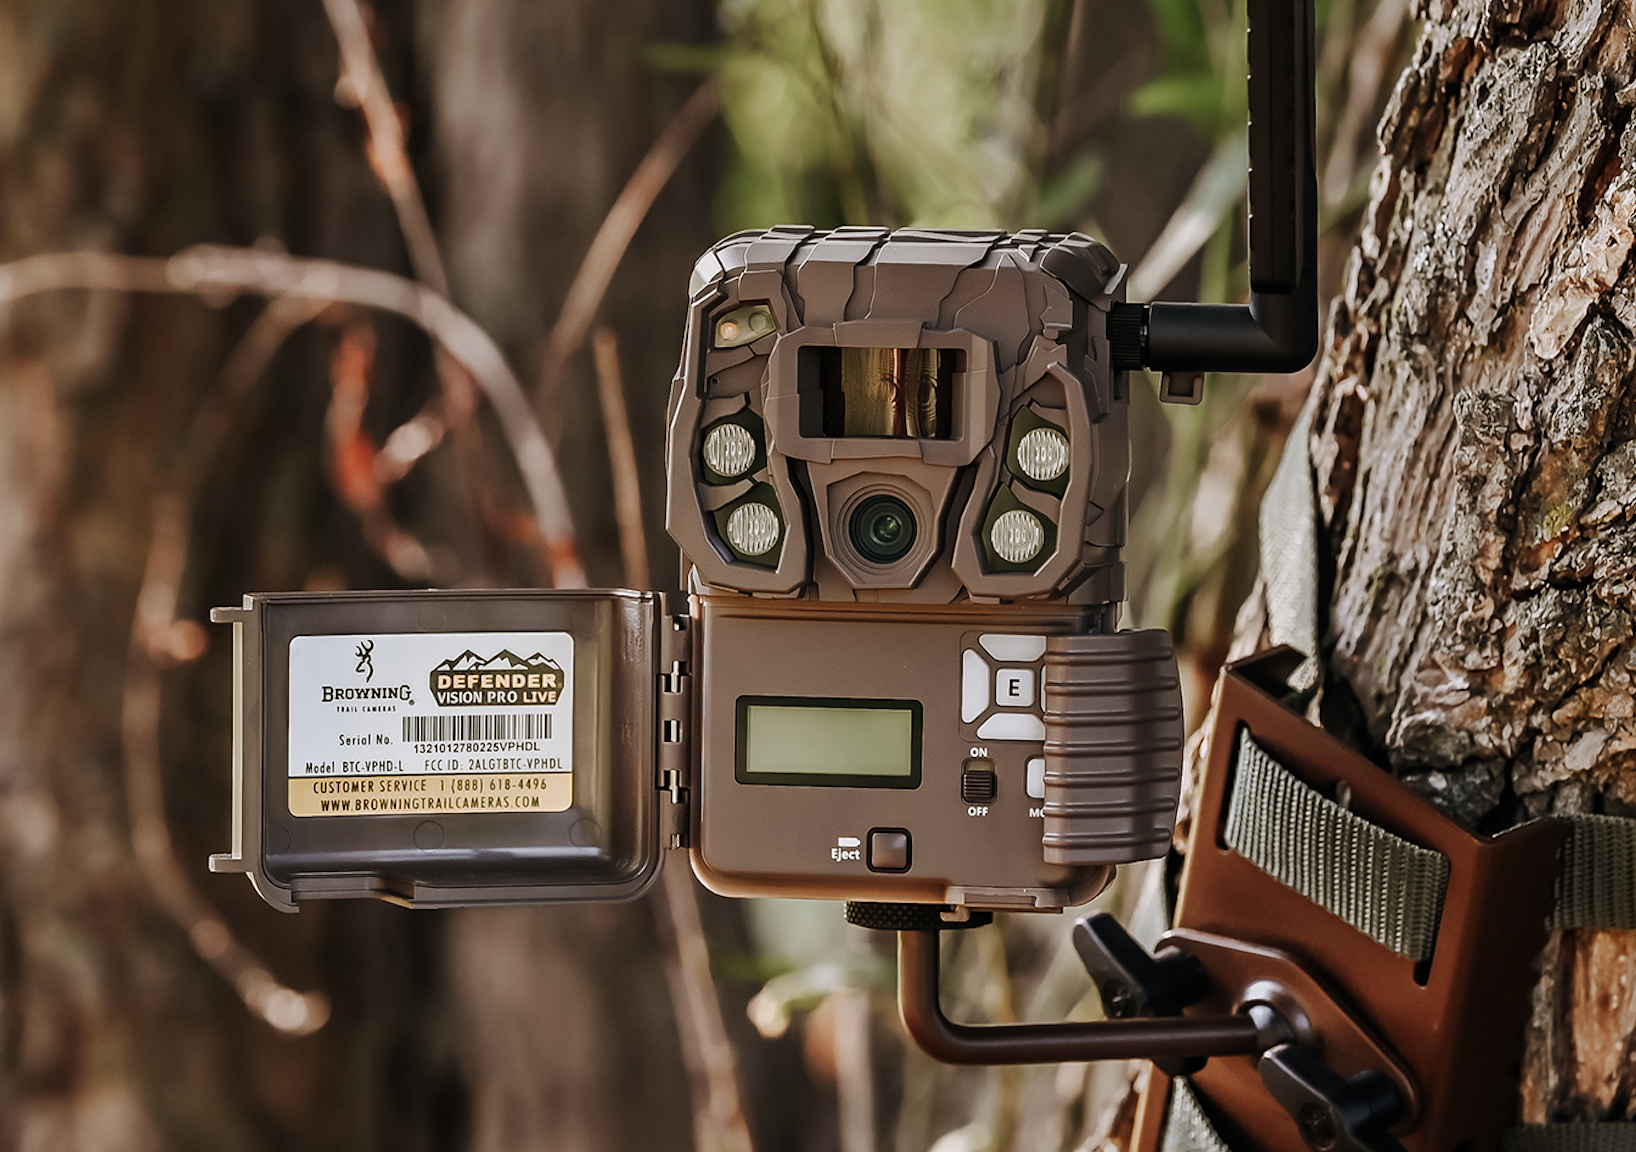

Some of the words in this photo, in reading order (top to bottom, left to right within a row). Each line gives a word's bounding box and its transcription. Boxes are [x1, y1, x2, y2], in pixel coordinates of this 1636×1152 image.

[438, 673, 556, 689] DEFENDER
[1009, 679, 1020, 696] E
[437, 691, 482, 704] VISION
[487, 691, 518, 704] PRO
[523, 691, 556, 704] LIVE
[339, 734, 372, 746] Serial
[377, 734, 394, 746] No.
[414, 742, 540, 753] 1321012780225VPHDL
[970, 748, 988, 757] ON
[306, 762, 335, 774] Model
[342, 762, 404, 772] BTC-VPHD-L
[425, 760, 443, 771] FCC
[447, 760, 463, 770] ID:
[468, 758, 562, 770] 2ALGTBTC-VPHDL
[314, 781, 374, 794] CUSTOMER
[380, 780, 426, 792] SERVICE
[440, 780, 444, 791] 1
[451, 779, 484, 793] (888)
[490, 779, 547, 791] 618-4496
[321, 796, 540, 811] WWW.BROWNINGTRAILCAMERAS.COM
[968, 806, 989, 817] OFF
[831, 848, 860, 861] Eject
